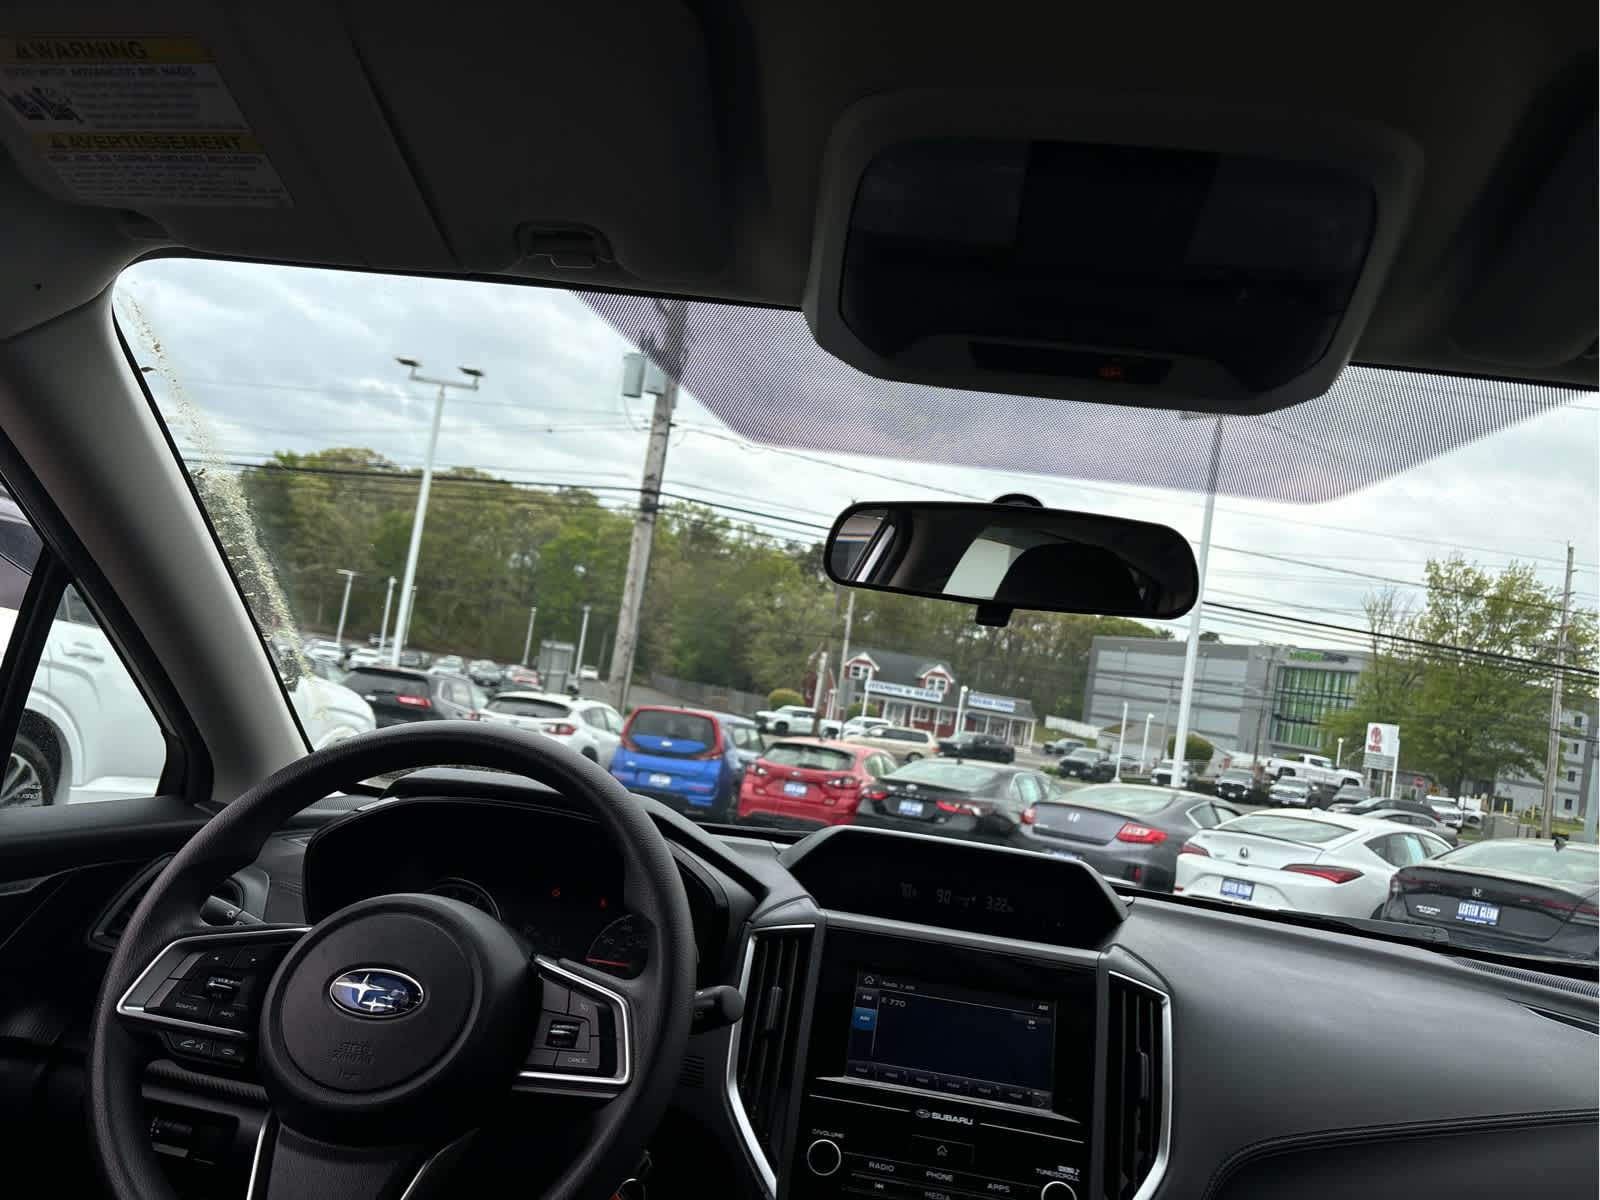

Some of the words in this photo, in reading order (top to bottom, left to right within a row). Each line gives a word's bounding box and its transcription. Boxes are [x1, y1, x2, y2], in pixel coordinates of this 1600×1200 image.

[31, 40, 148, 59] WARNING
[1459, 903, 1479, 916] LESTER
[1480, 906, 1499, 919] GLENN
[931, 1112, 974, 1126] SUBARU
[868, 1161, 895, 1173] RADIO
[925, 1170, 954, 1184] PHONE
[987, 1182, 1011, 1193] APPS
